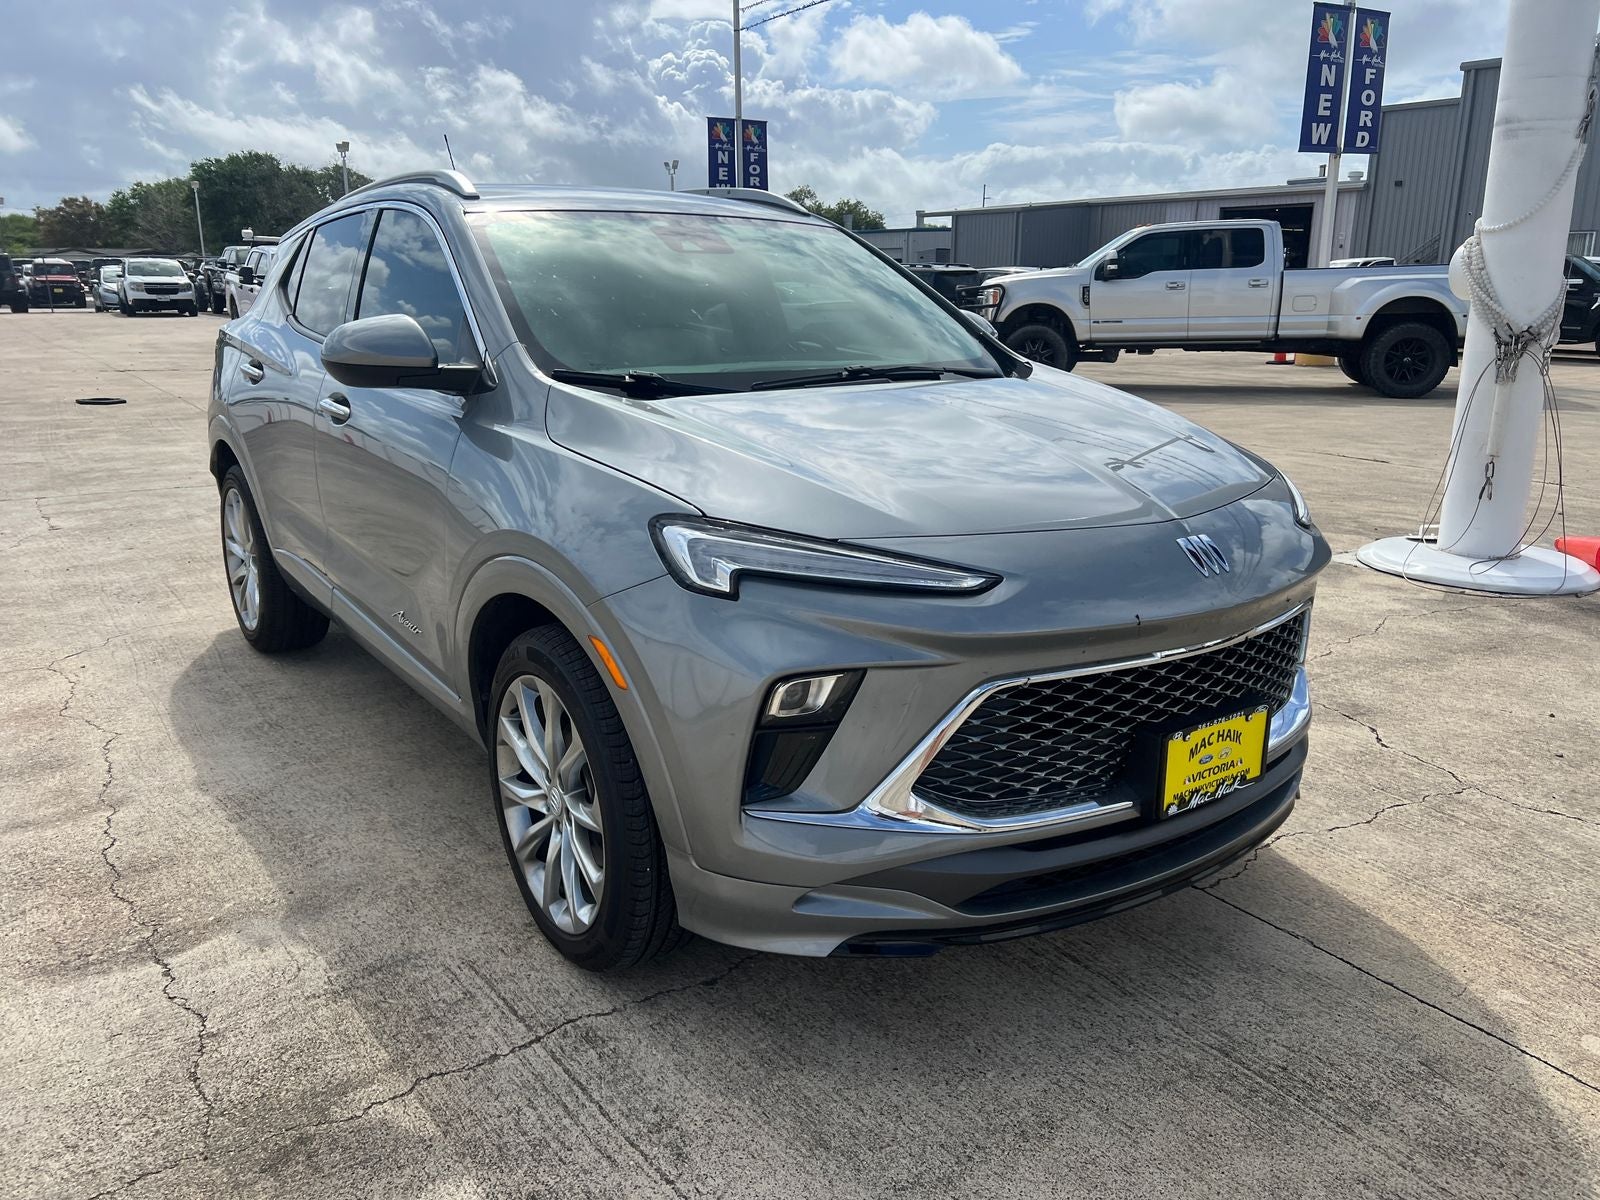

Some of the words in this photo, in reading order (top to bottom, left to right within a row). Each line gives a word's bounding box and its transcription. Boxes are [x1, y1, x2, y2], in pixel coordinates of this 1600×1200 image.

[1311, 64, 1336, 145] NEW
[1355, 68, 1376, 148] FORD
[716, 151, 730, 188] NE
[1188, 731, 1215, 762] MAC
[1216, 729, 1242, 745] HAIK
[1191, 760, 1236, 783] VICTORIA
[1186, 790, 1215, 809] Mac
[1215, 778, 1248, 799] Haik
